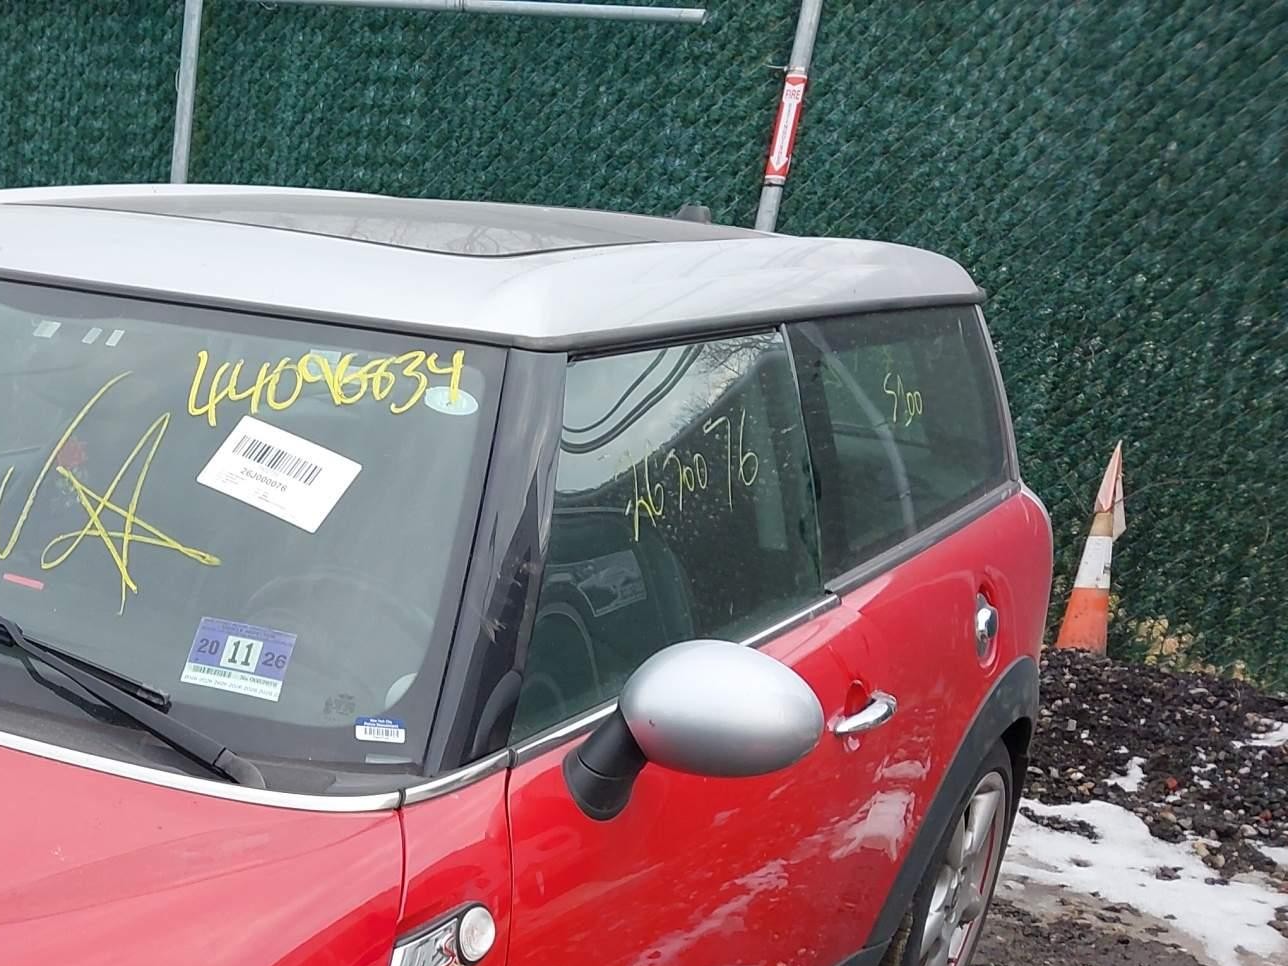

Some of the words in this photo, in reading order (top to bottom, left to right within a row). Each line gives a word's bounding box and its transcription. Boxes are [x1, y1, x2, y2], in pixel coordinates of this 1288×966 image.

[785, 88, 801, 100] FIRE
[197, 638, 220, 655] 20
[227, 640, 254, 667] 11
[262, 651, 288, 669] 26
